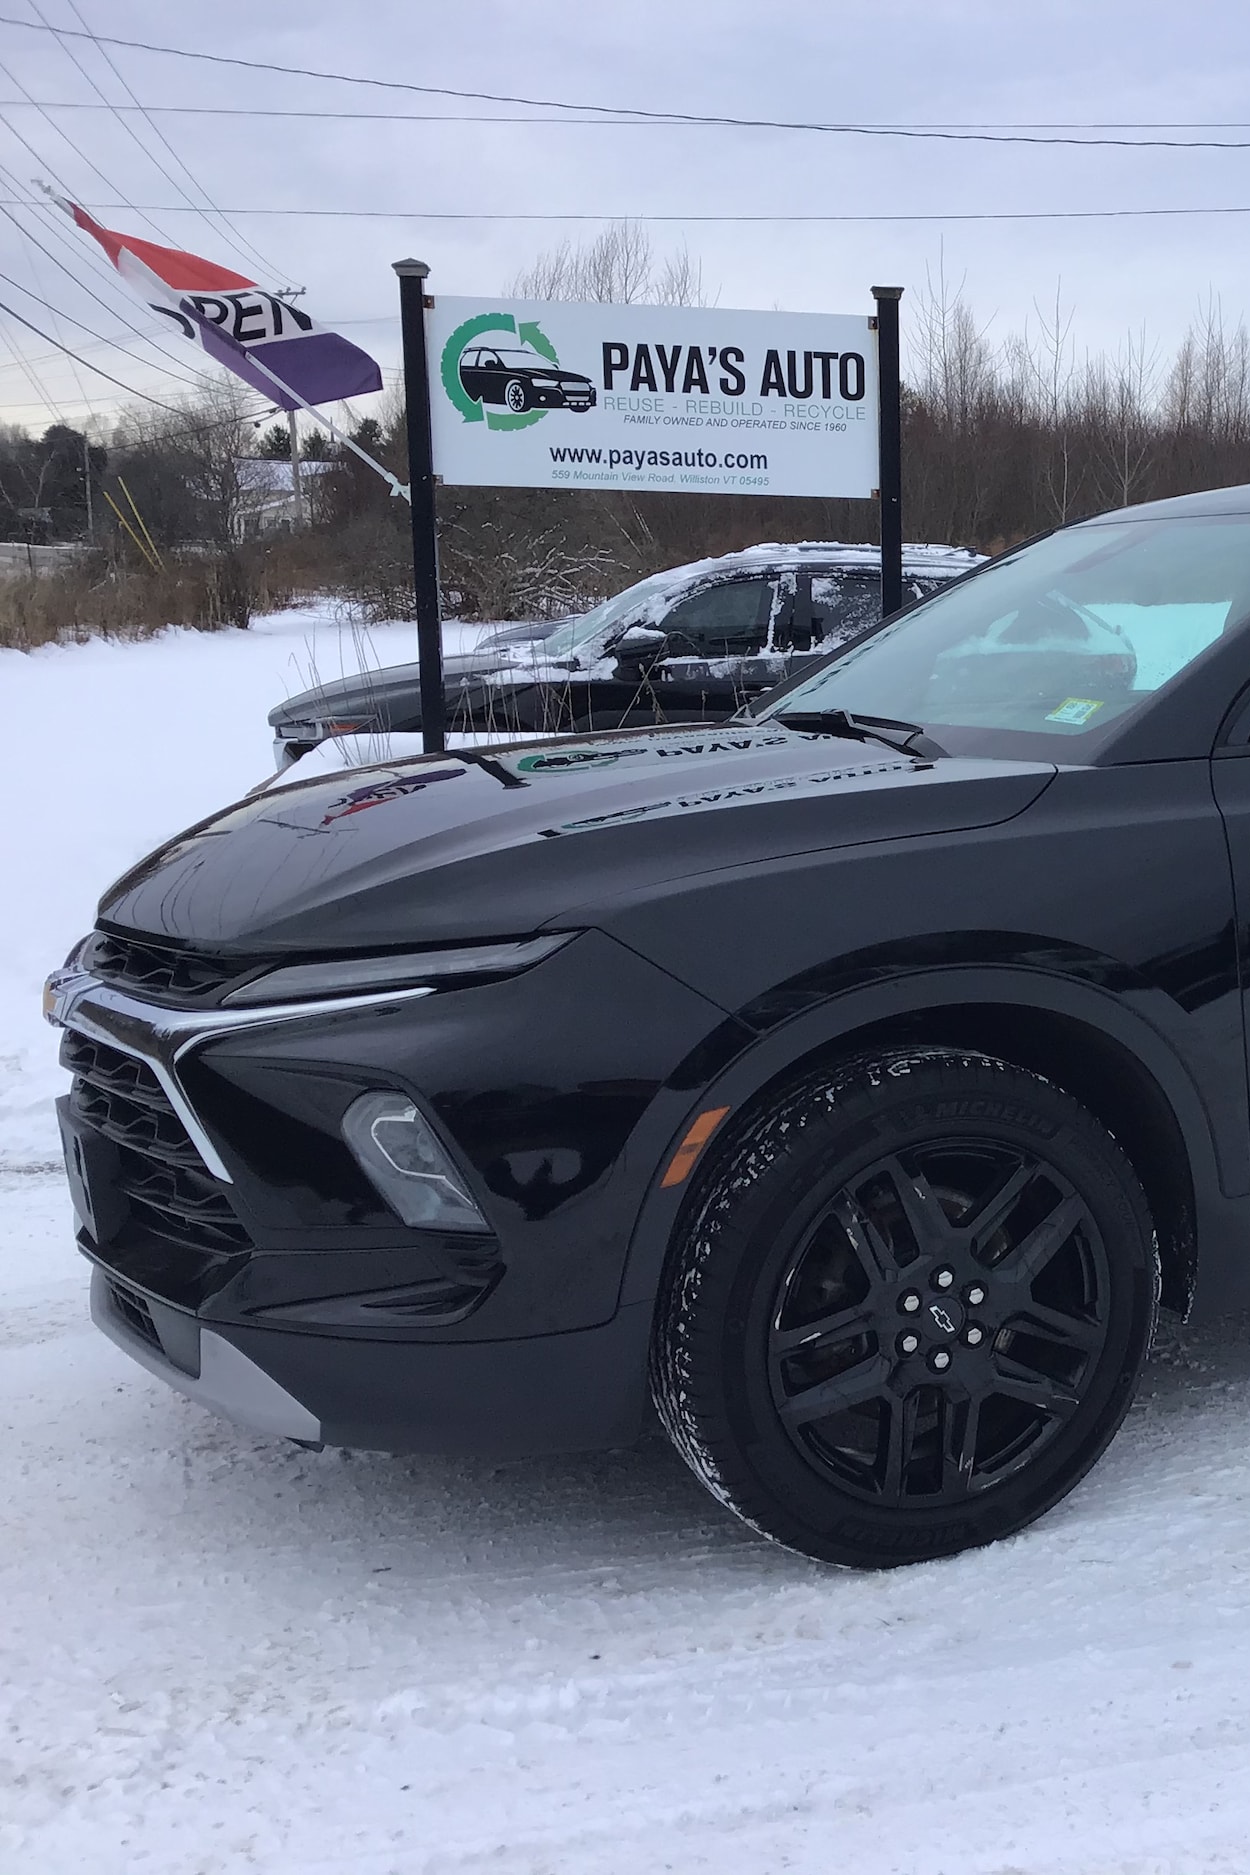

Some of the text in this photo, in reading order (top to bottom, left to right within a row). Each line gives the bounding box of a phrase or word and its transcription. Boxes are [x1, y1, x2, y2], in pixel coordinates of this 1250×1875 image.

[602, 342, 866, 401] PAYA'S AUTO
[604, 397, 665, 413] REUSE
[686, 400, 763, 416] REBUILD
[784, 404, 866, 420] RECYCLE
[623, 415, 847, 432] FAMILY OWNED AND OPERATED SINCE 1960
[550, 447, 768, 470] www.payasauto.com
[552, 470, 570, 480] 559
[573, 471, 619, 481] Mountain
[622, 472, 645, 482] View
[680, 475, 720, 485] Williston
[723, 475, 737, 485] VT
[739, 477, 770, 486] 05495
